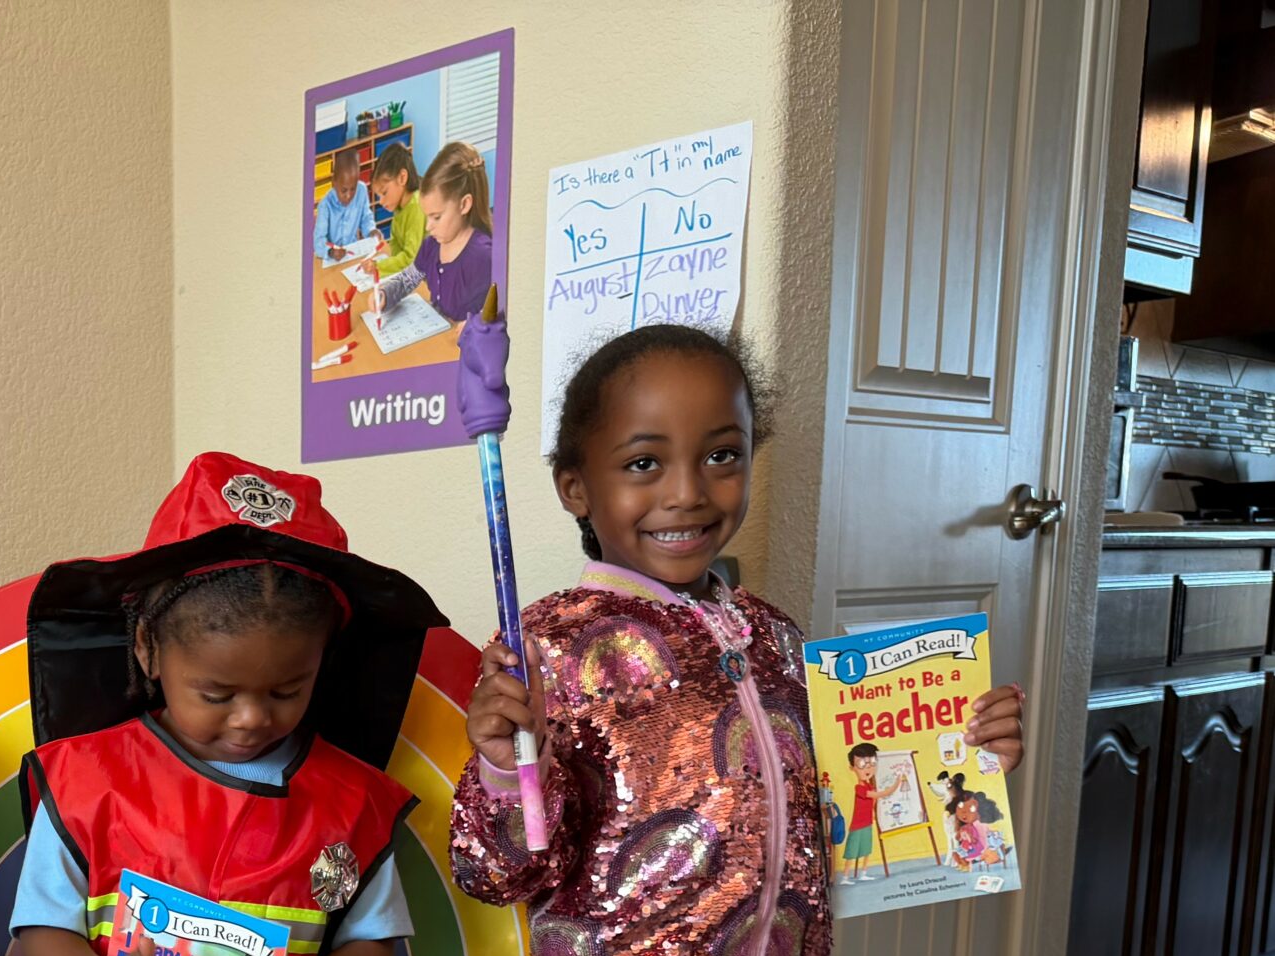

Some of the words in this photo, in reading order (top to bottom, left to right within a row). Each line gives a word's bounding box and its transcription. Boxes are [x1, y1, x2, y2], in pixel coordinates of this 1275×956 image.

[553, 173, 581, 196] Is
[583, 166, 621, 187] there
[624, 166, 635, 180] a
[676, 156, 692, 170] in
[703, 145, 743, 171] name
[563, 223, 608, 263] Yes
[673, 200, 713, 235] No
[548, 262, 639, 316] August
[644, 246, 728, 281] Zayne
[349, 392, 447, 429] Writing
[247, 491, 271, 506] #1
[844, 656, 858, 677] 1
[871, 656, 878, 671] I
[880, 648, 913, 667] Can
[915, 634, 962, 654] Read!
[839, 690, 844, 704] I
[850, 684, 893, 702] Want
[898, 675, 916, 689] to
[921, 671, 945, 687] Be
[950, 669, 961, 682] a
[835, 691, 969, 746] Teacher
[125, 931, 132, 948] I
[147, 905, 159, 926] 1
[172, 917, 179, 931] I
[181, 920, 210, 937] Can
[214, 924, 258, 952] Read!
